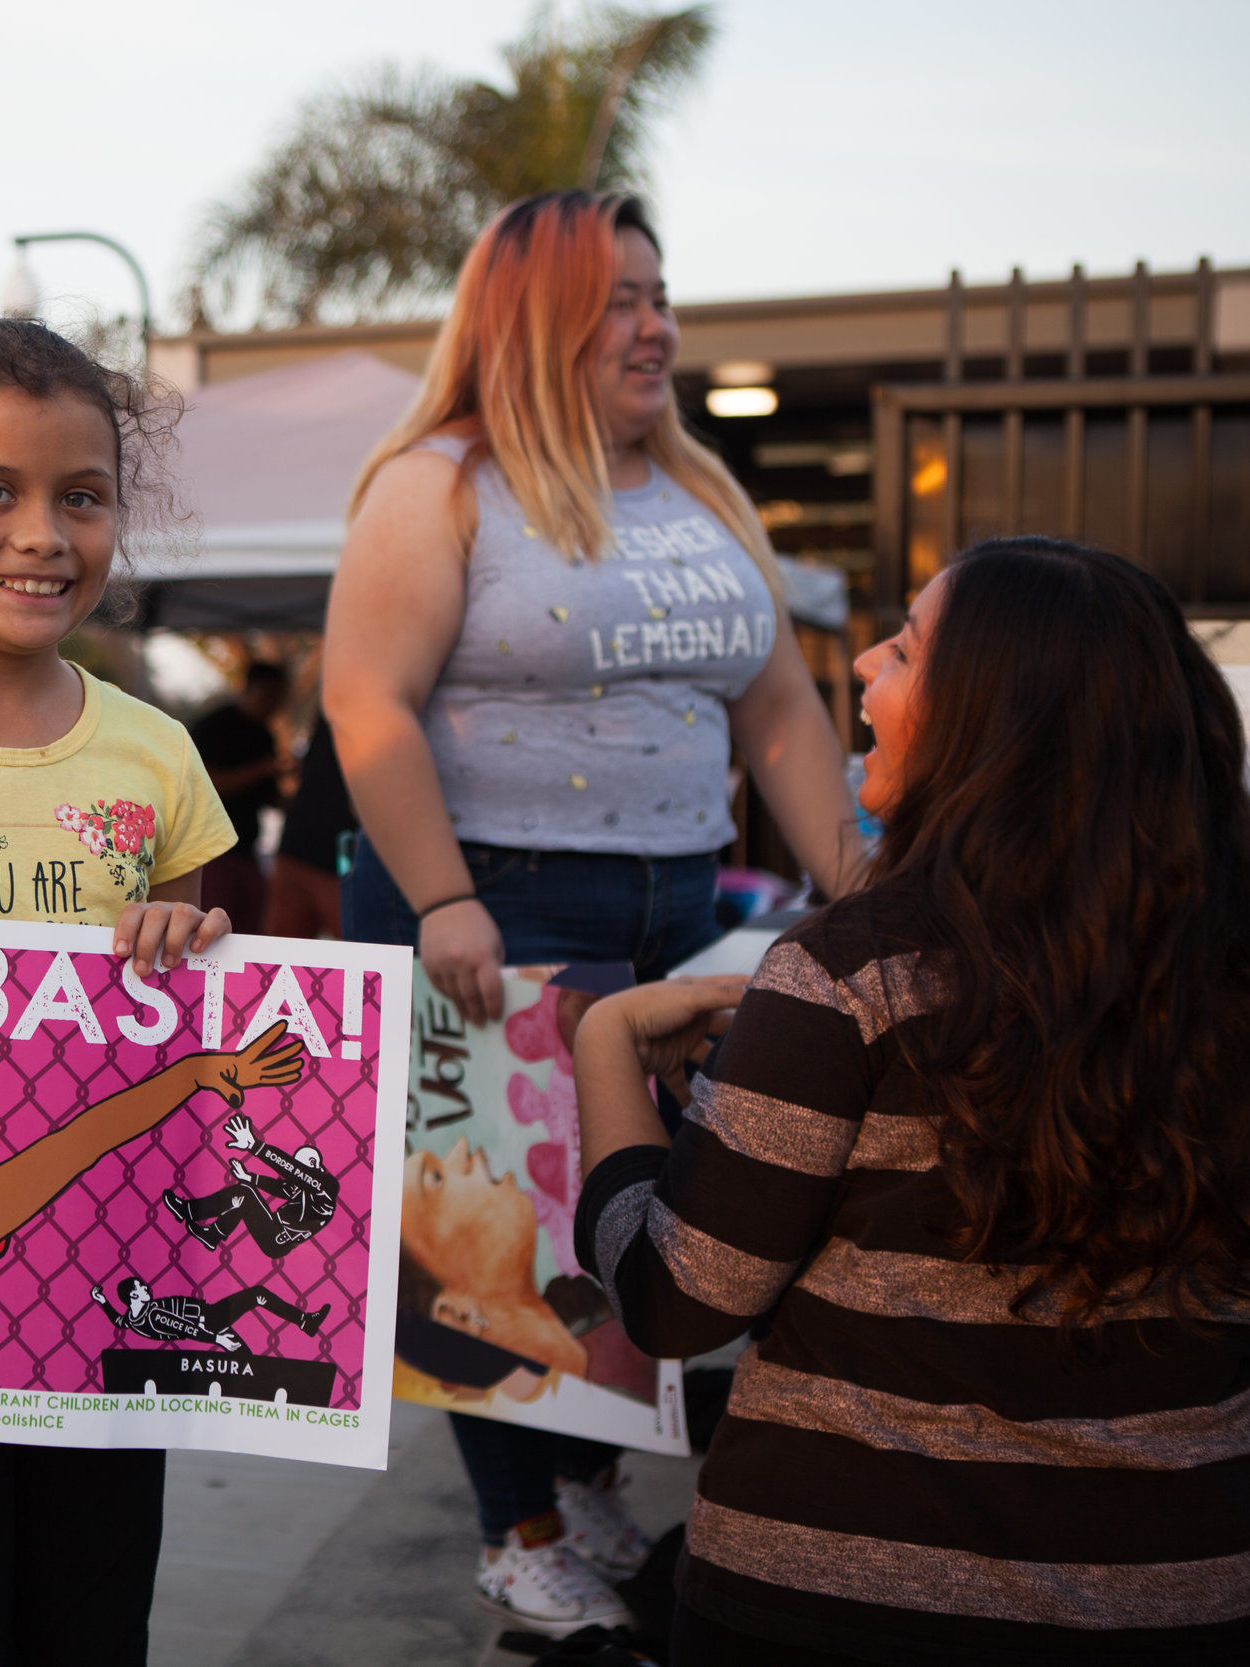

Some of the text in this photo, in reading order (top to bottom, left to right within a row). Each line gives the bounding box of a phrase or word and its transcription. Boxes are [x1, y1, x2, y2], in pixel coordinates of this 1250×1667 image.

[614, 514, 729, 561] ESHER
[621, 560, 746, 608] THAN
[32, 860, 88, 914] ARE
[418, 996, 475, 1133] VOTE
[264, 1149, 323, 1191] BORDER PATROL
[154, 1313, 199, 1337] POLICE ICE
[180, 1357, 254, 1377] BASURA
[46, 1395, 119, 1413] CHILDREN
[125, 1398, 156, 1412] AND
[160, 1398, 233, 1415] LOCKING
[238, 1402, 280, 1421] THEM
[285, 1407, 301, 1423] IN
[305, 1410, 360, 1430] CAGES
